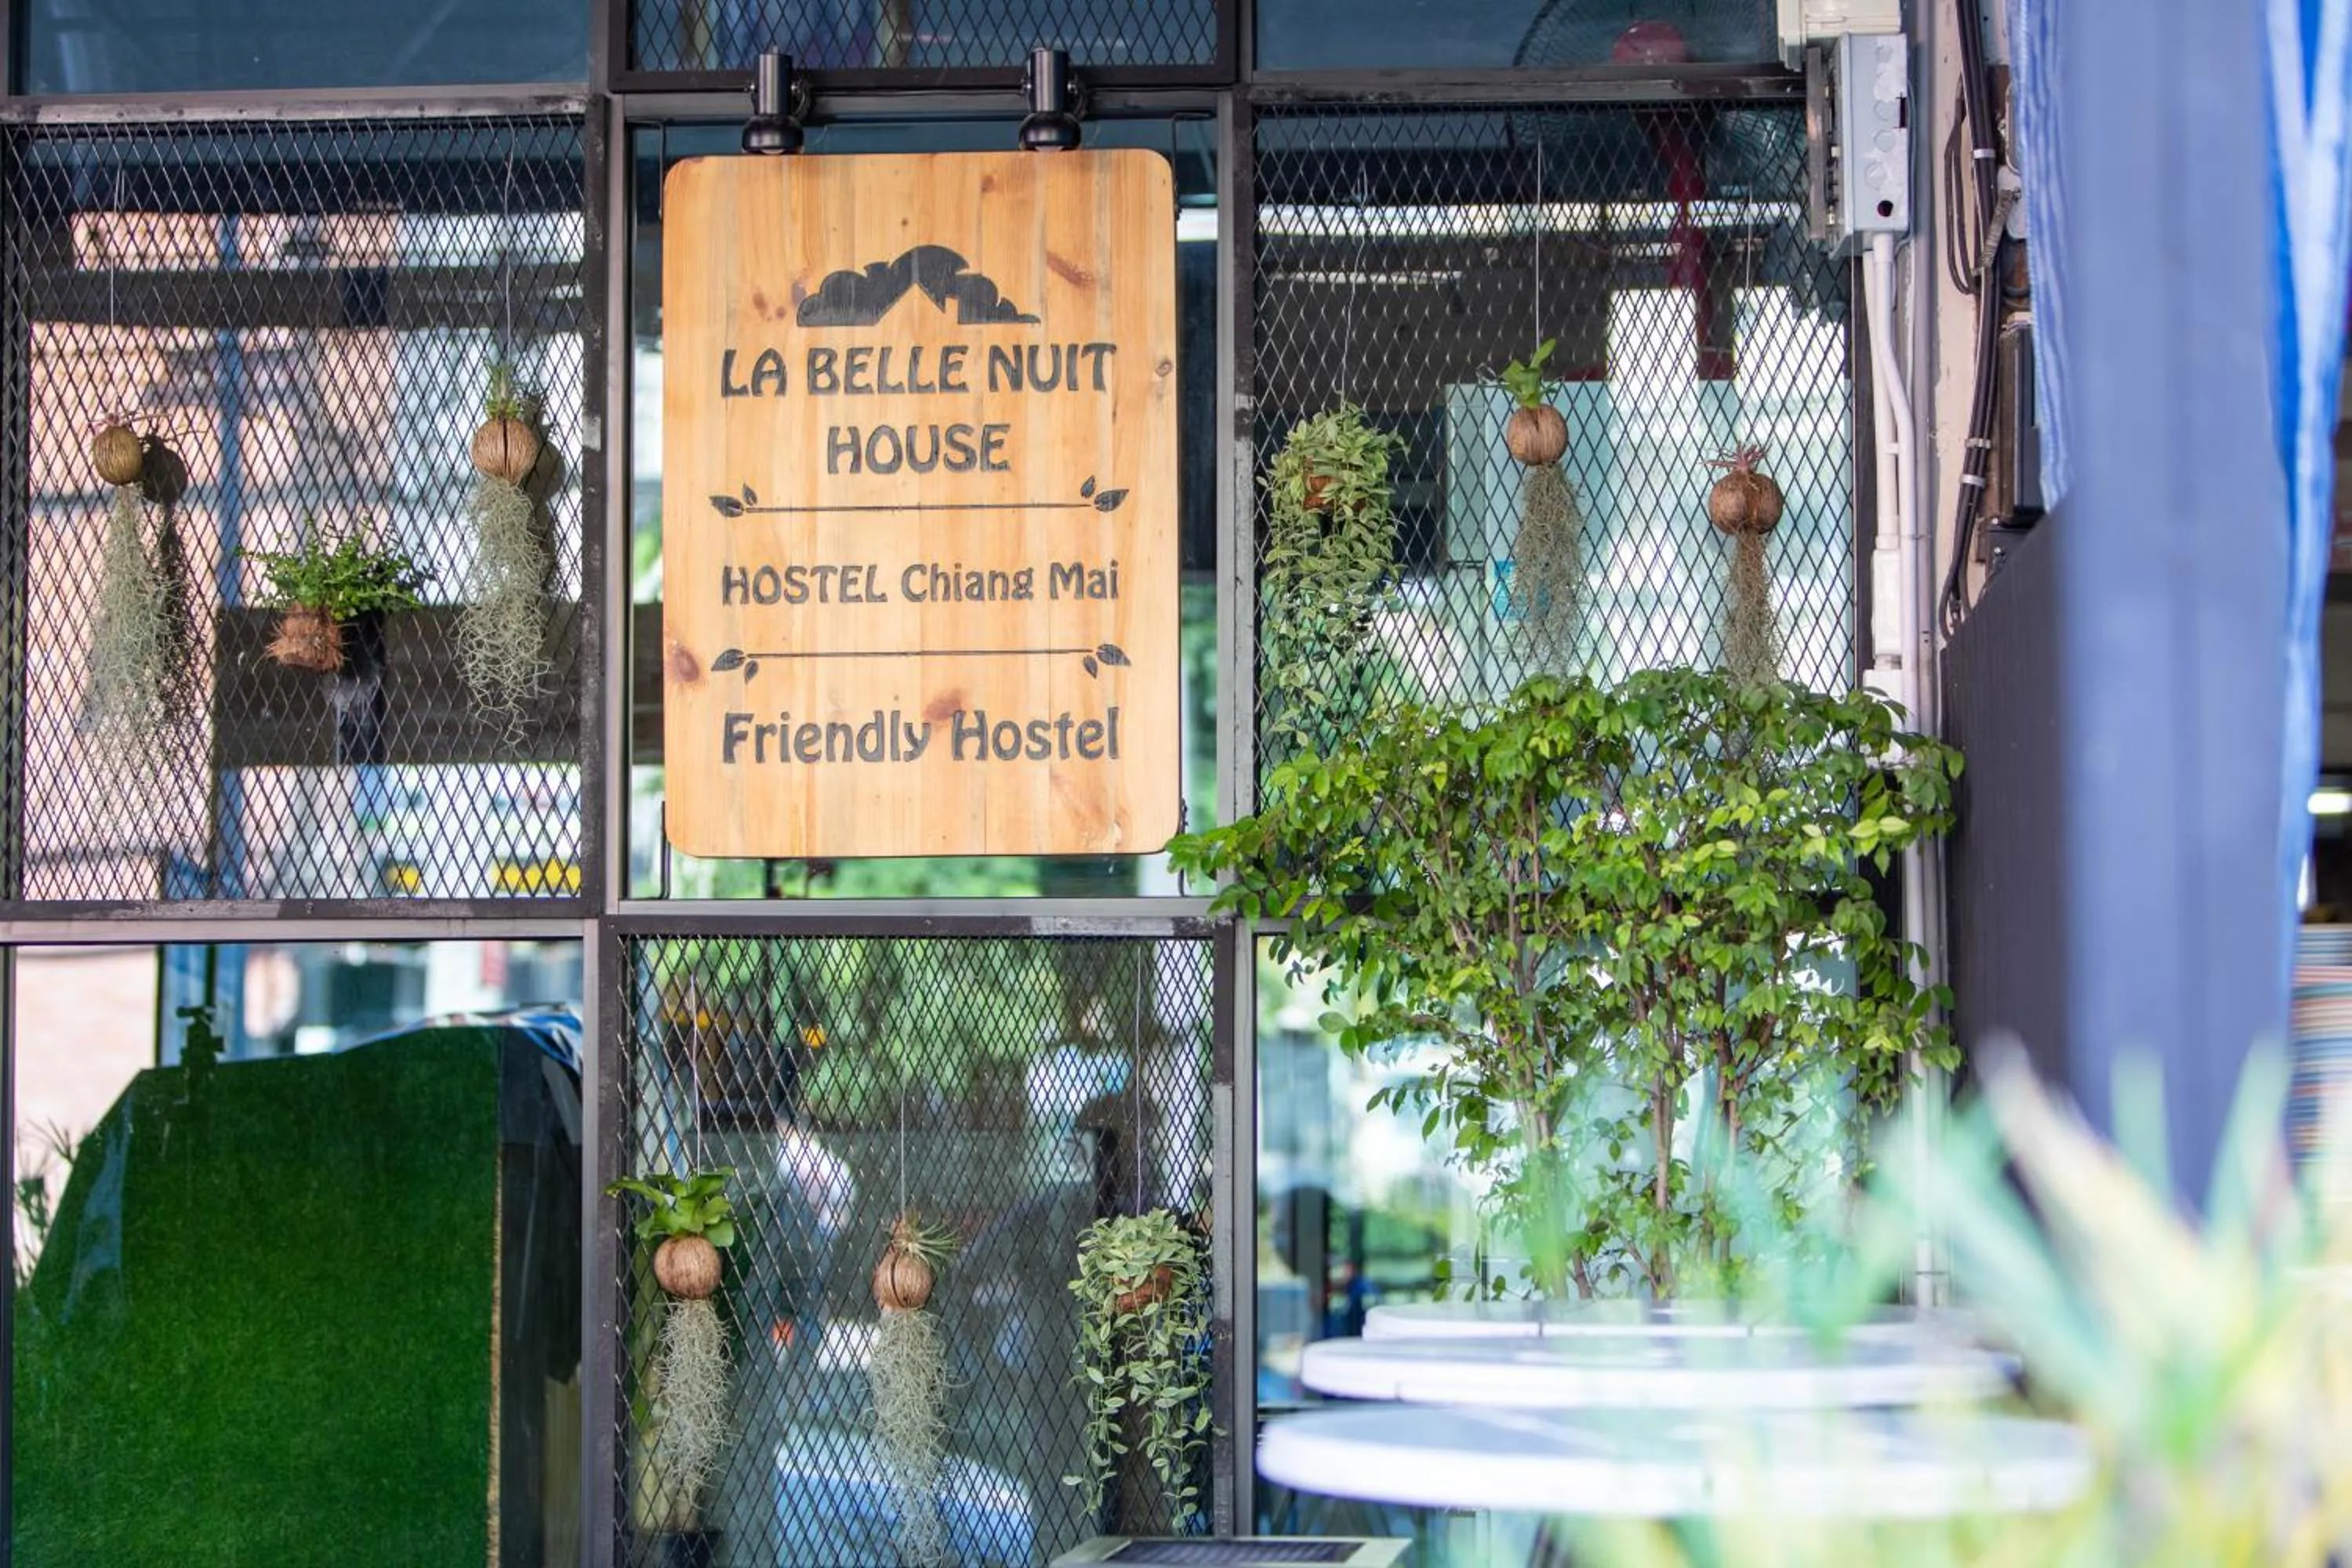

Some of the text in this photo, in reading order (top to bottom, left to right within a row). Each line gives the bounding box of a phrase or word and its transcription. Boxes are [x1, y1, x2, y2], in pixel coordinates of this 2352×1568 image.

[720, 342, 1117, 398] LA BELLE NUIT
[827, 423, 1011, 474] HOUSE
[722, 560, 1119, 605] HOSTEL Chiang Mai
[723, 706, 1119, 764] Friendly Hostel
